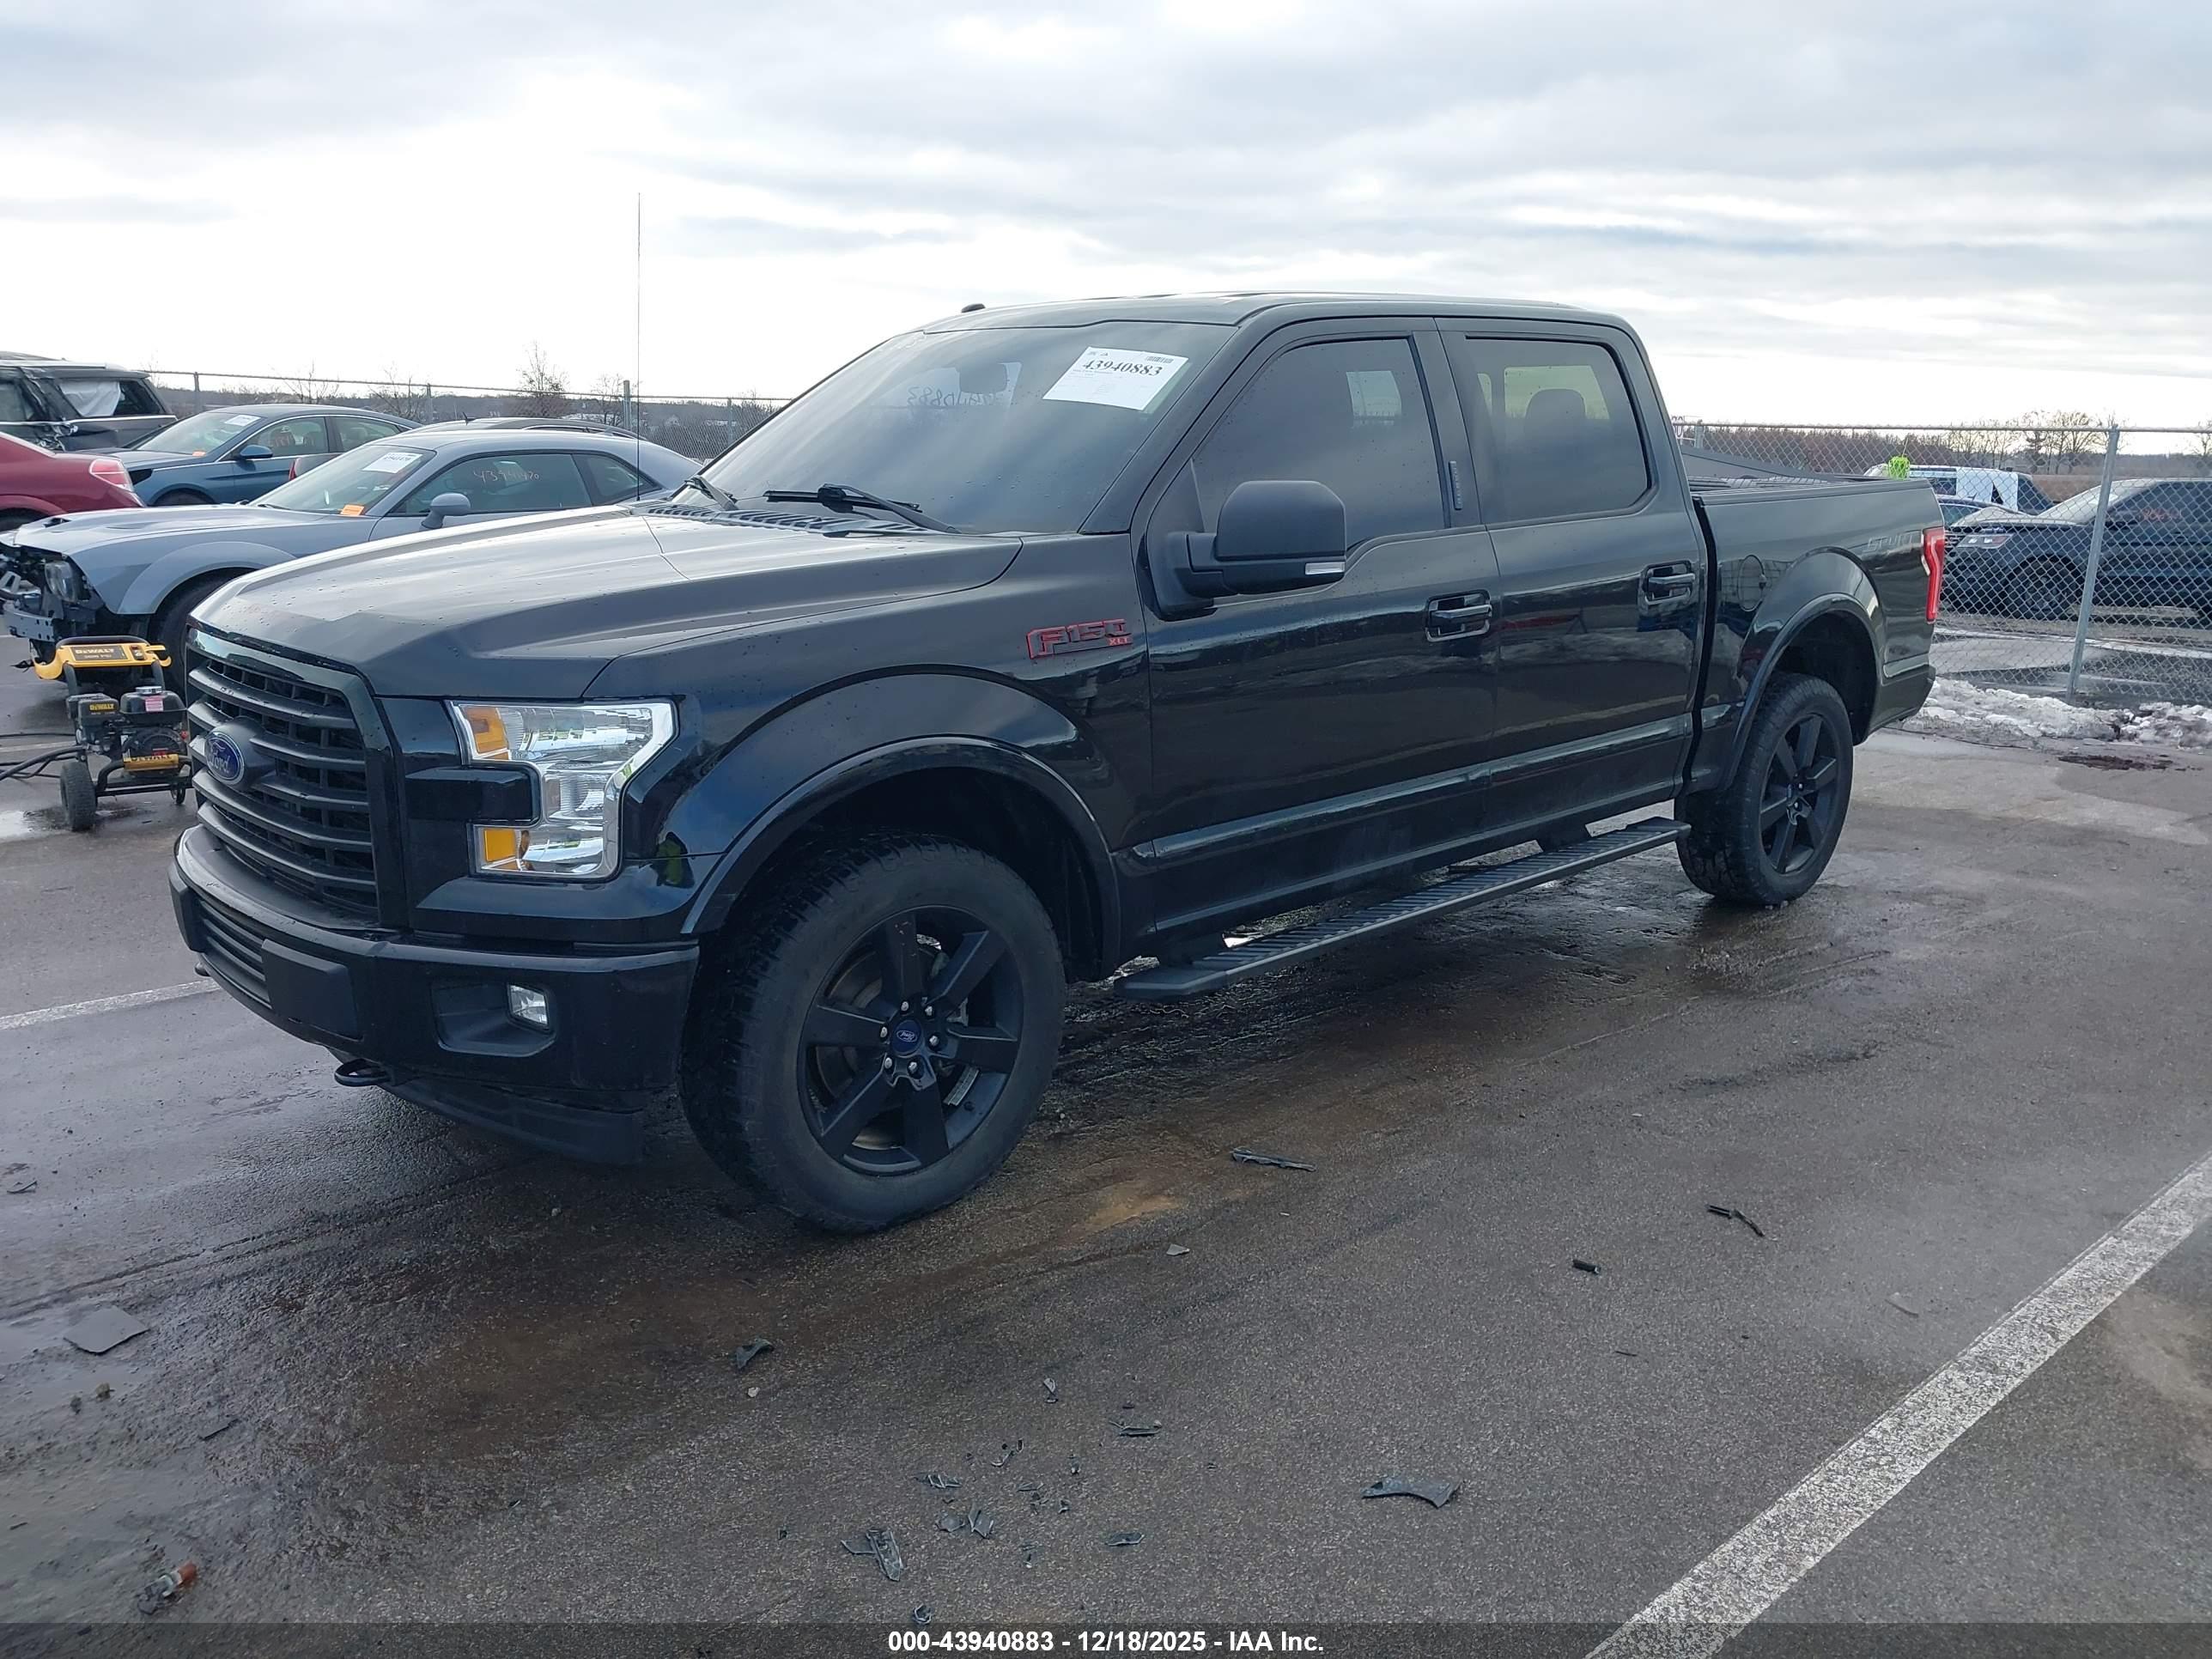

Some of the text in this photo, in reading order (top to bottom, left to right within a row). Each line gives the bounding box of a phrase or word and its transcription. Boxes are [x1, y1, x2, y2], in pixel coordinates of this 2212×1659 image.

[1082, 359, 1164, 377] 43940883
[1109, 636, 1132, 647] XLT
[209, 741, 231, 775] Ford
